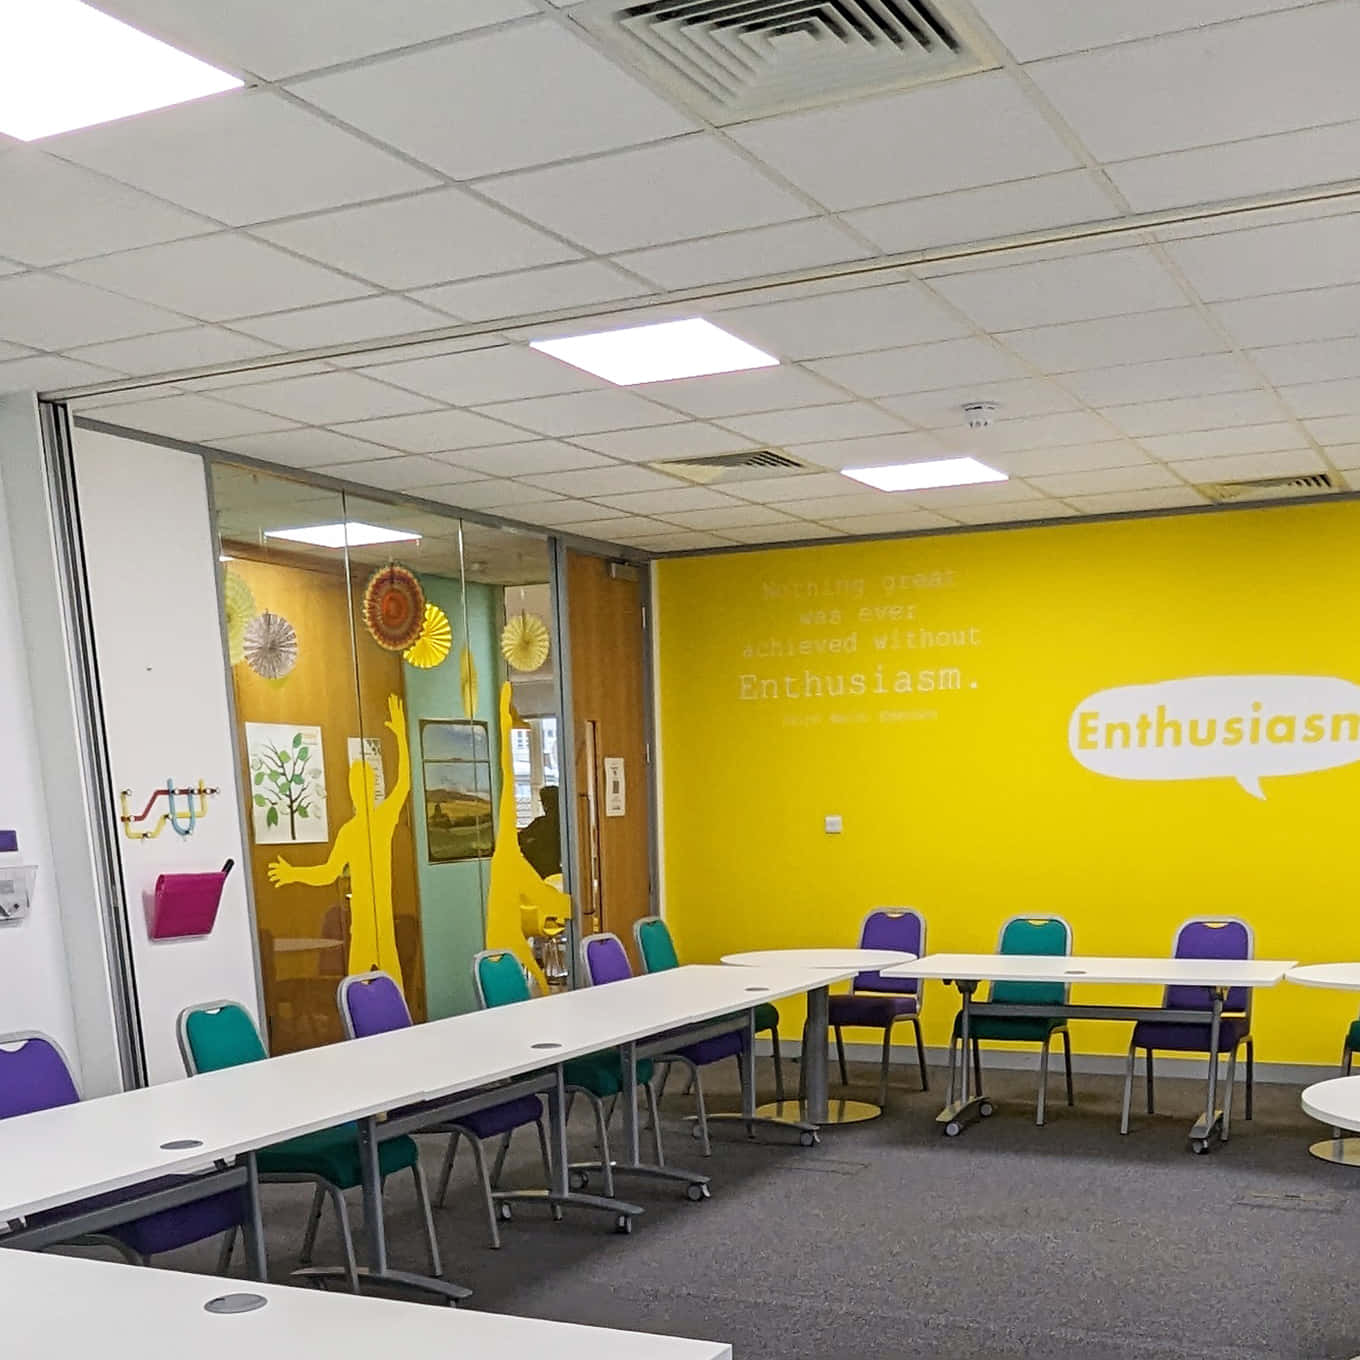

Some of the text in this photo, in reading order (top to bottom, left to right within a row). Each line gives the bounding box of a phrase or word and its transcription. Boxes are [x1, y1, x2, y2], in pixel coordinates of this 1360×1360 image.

[858, 602, 919, 622] ever
[742, 624, 982, 660] achieved without
[737, 662, 980, 701] Enthusiasm.
